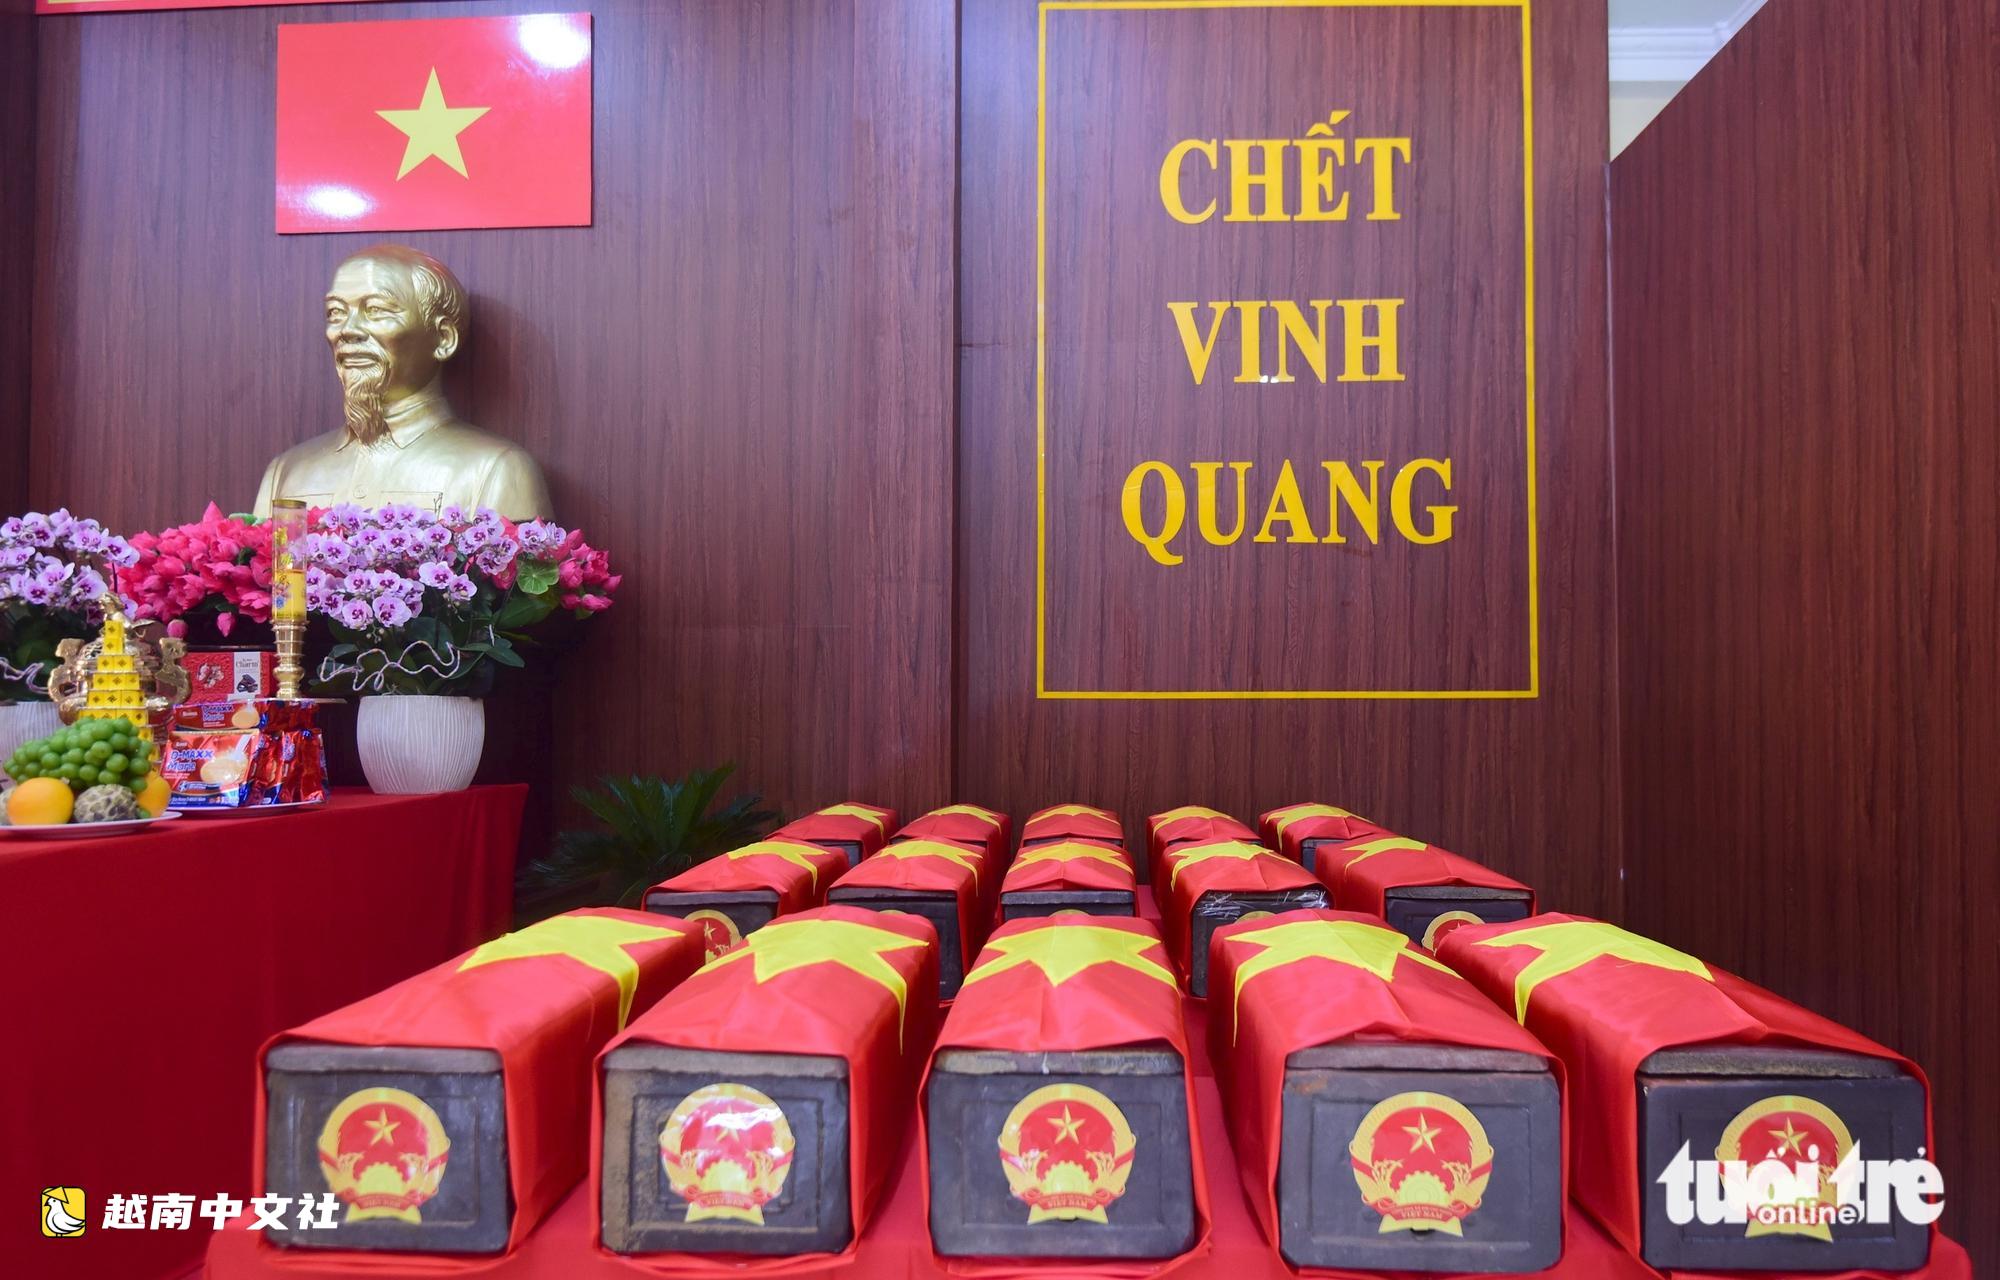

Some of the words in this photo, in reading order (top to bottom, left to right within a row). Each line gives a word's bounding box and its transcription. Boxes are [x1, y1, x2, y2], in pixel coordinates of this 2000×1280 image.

[1159, 110, 1411, 225] CHẾT
[1167, 298, 1406, 386] VINH
[1120, 457, 1458, 566] QUANG
